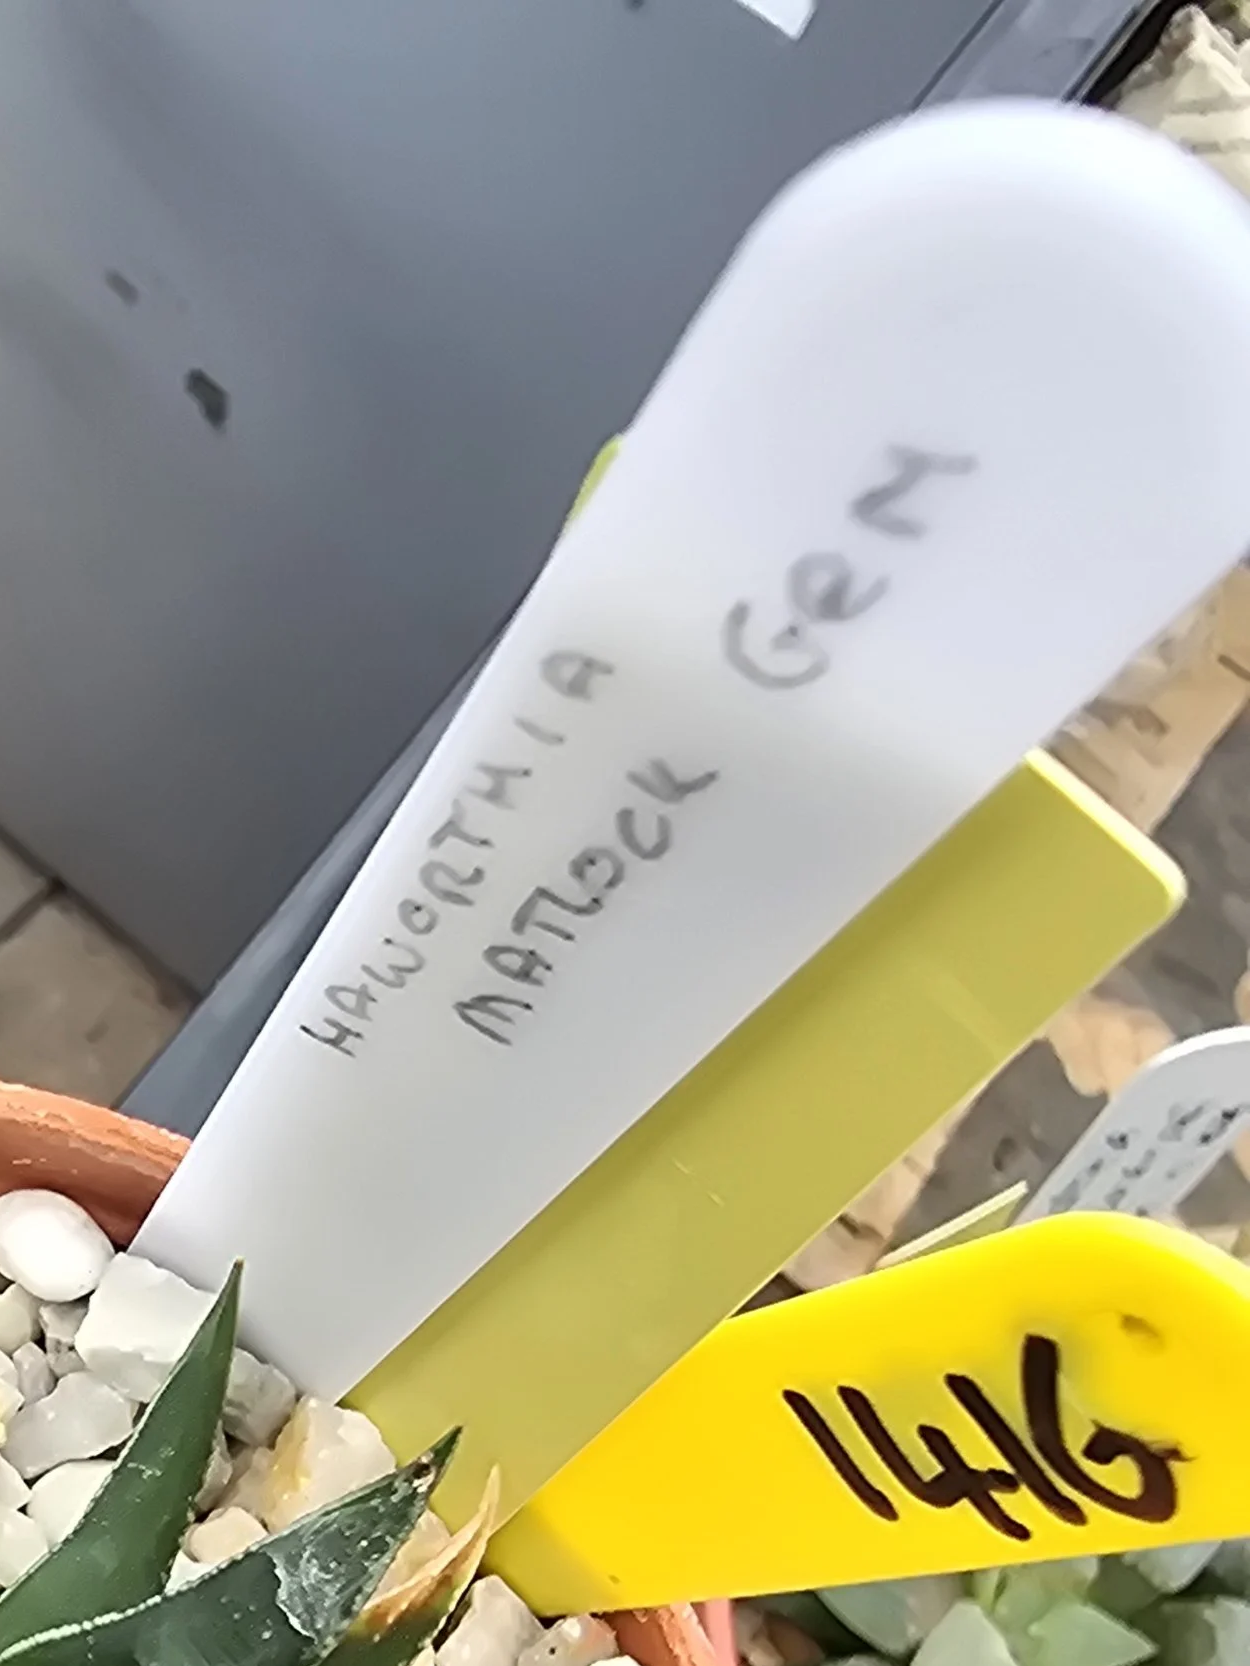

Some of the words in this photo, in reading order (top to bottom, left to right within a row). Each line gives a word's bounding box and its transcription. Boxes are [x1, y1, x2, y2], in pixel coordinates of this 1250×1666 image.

[299, 648, 614, 1057] HAWORTHIA
[454, 759, 718, 1045] MATLOCK
[782, 1333, 1193, 1541] 1416
